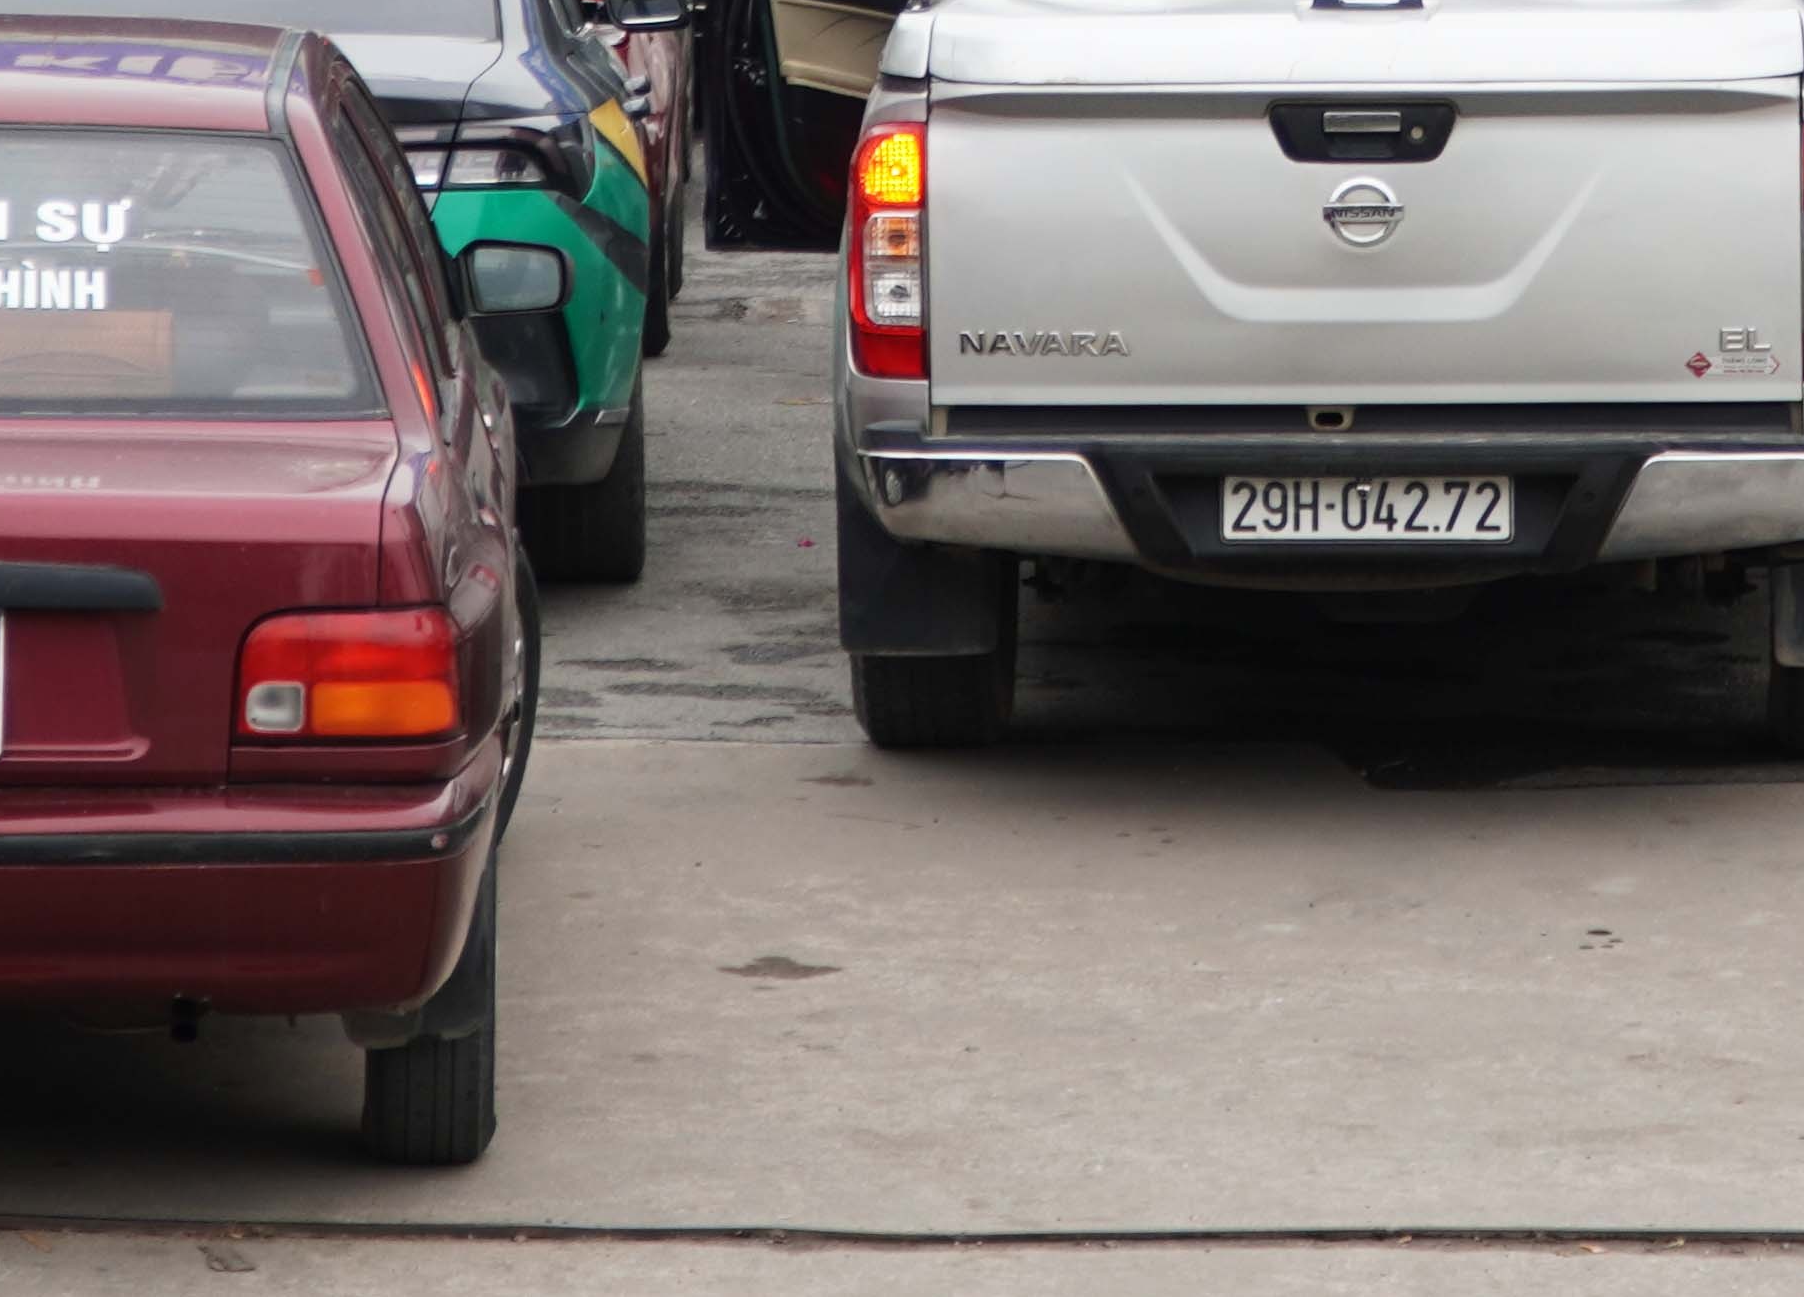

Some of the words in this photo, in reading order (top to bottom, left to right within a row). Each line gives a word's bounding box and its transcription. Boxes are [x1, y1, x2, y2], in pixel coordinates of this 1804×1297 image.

[35, 197, 134, 253] SỰ
[1330, 207, 1396, 219] NISSAN
[958, 329, 1130, 357] NAVARA
[1719, 326, 1773, 352] EL
[1230, 480, 1502, 533] 29H-042.72
